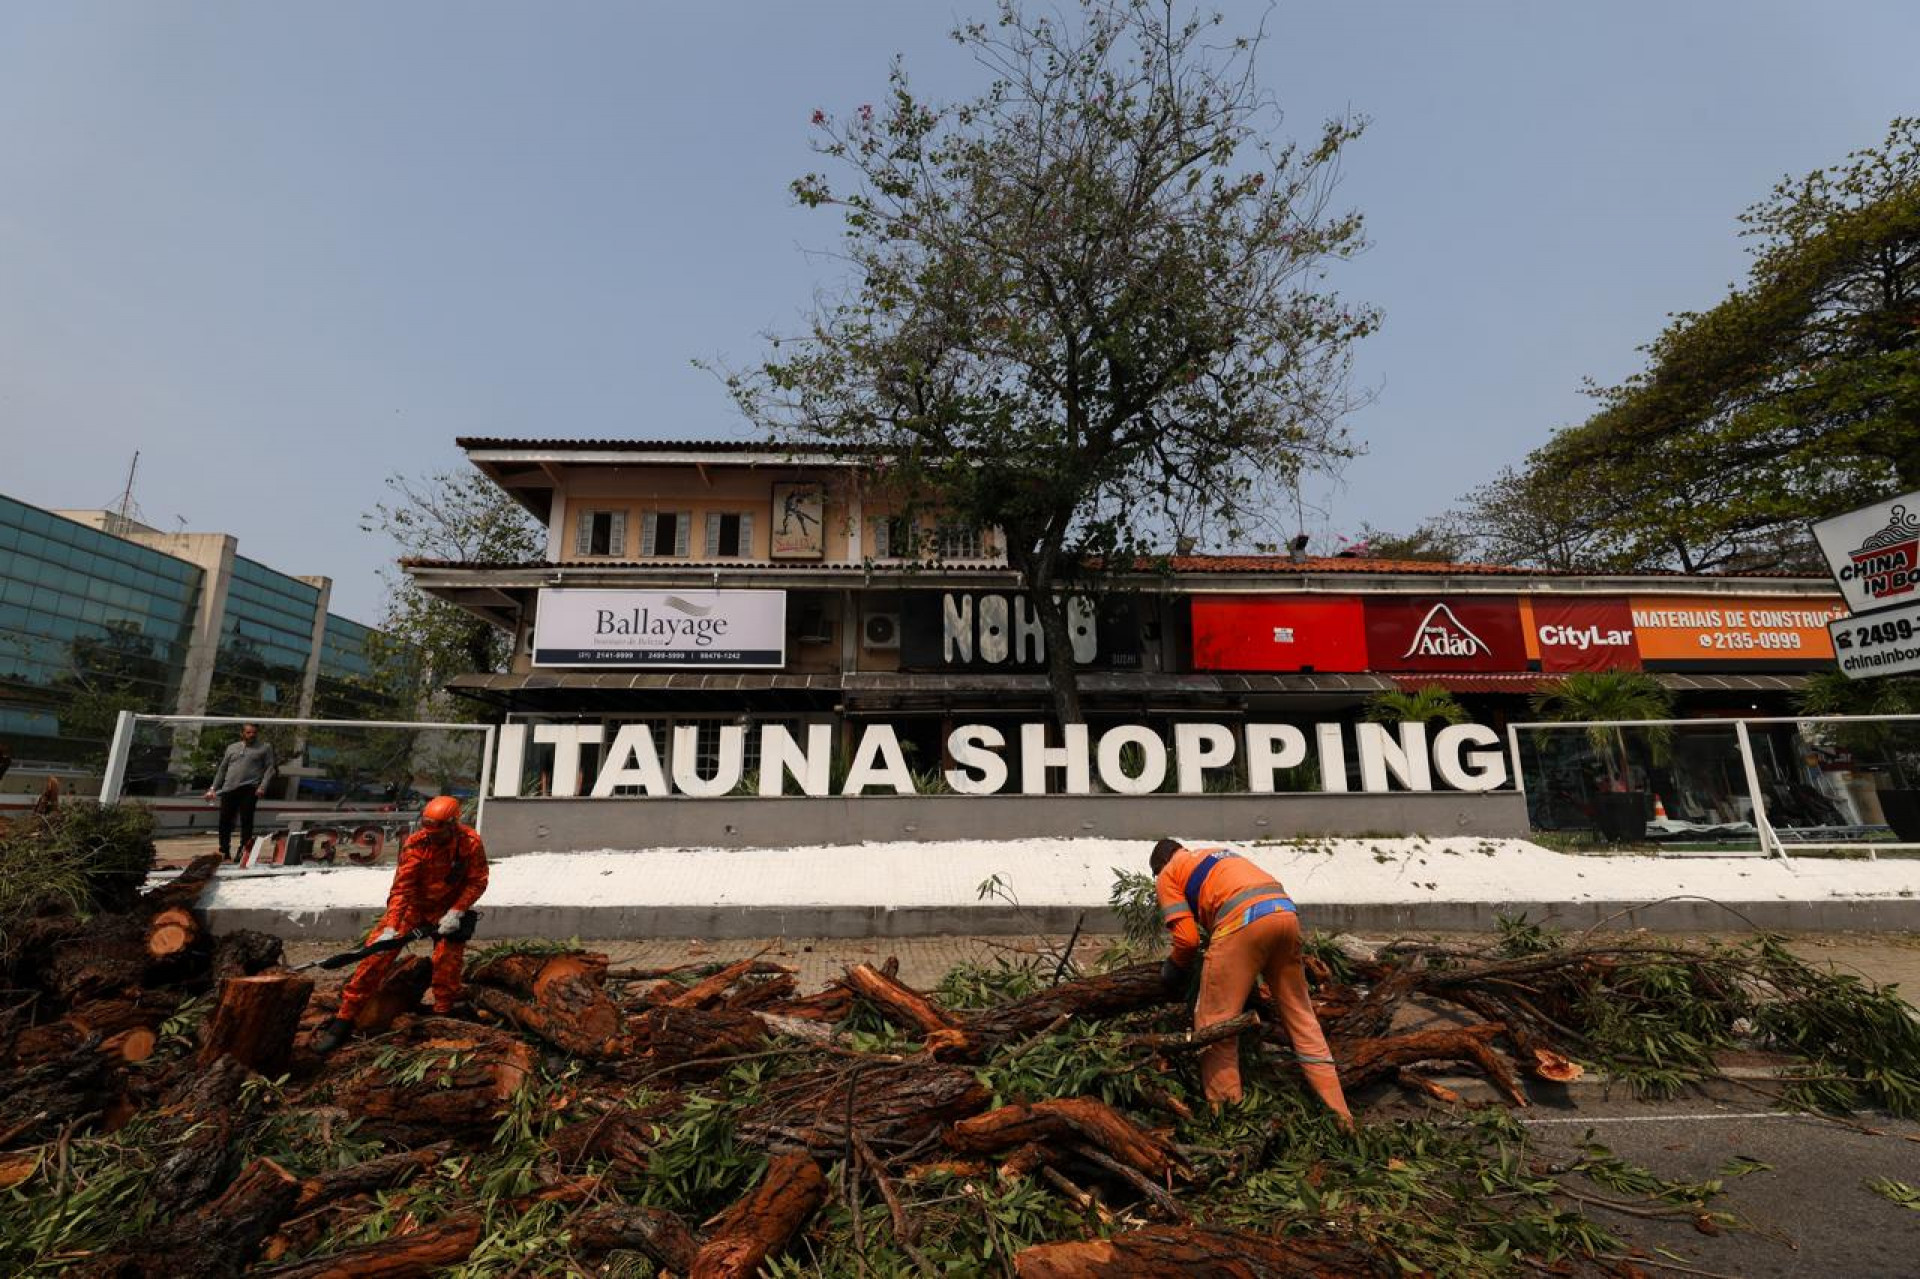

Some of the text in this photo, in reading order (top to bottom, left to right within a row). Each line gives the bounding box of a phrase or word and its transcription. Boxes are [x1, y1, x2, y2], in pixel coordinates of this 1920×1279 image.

[1840, 551, 1907, 582] CHINA
[1864, 576, 1887, 595] IN
[595, 608, 728, 646] Ballayage
[943, 593, 1098, 664] NOHO
[1632, 611, 1722, 628] MATERIAIS
[1725, 611, 1744, 628] DE
[1857, 616, 1920, 648] 2499-
[1419, 628, 1477, 656] Adão
[1539, 625, 1632, 650] CityLar
[1713, 632, 1800, 648] 2135-0999
[493, 721, 1508, 798] ITAUNA SHOPPING
